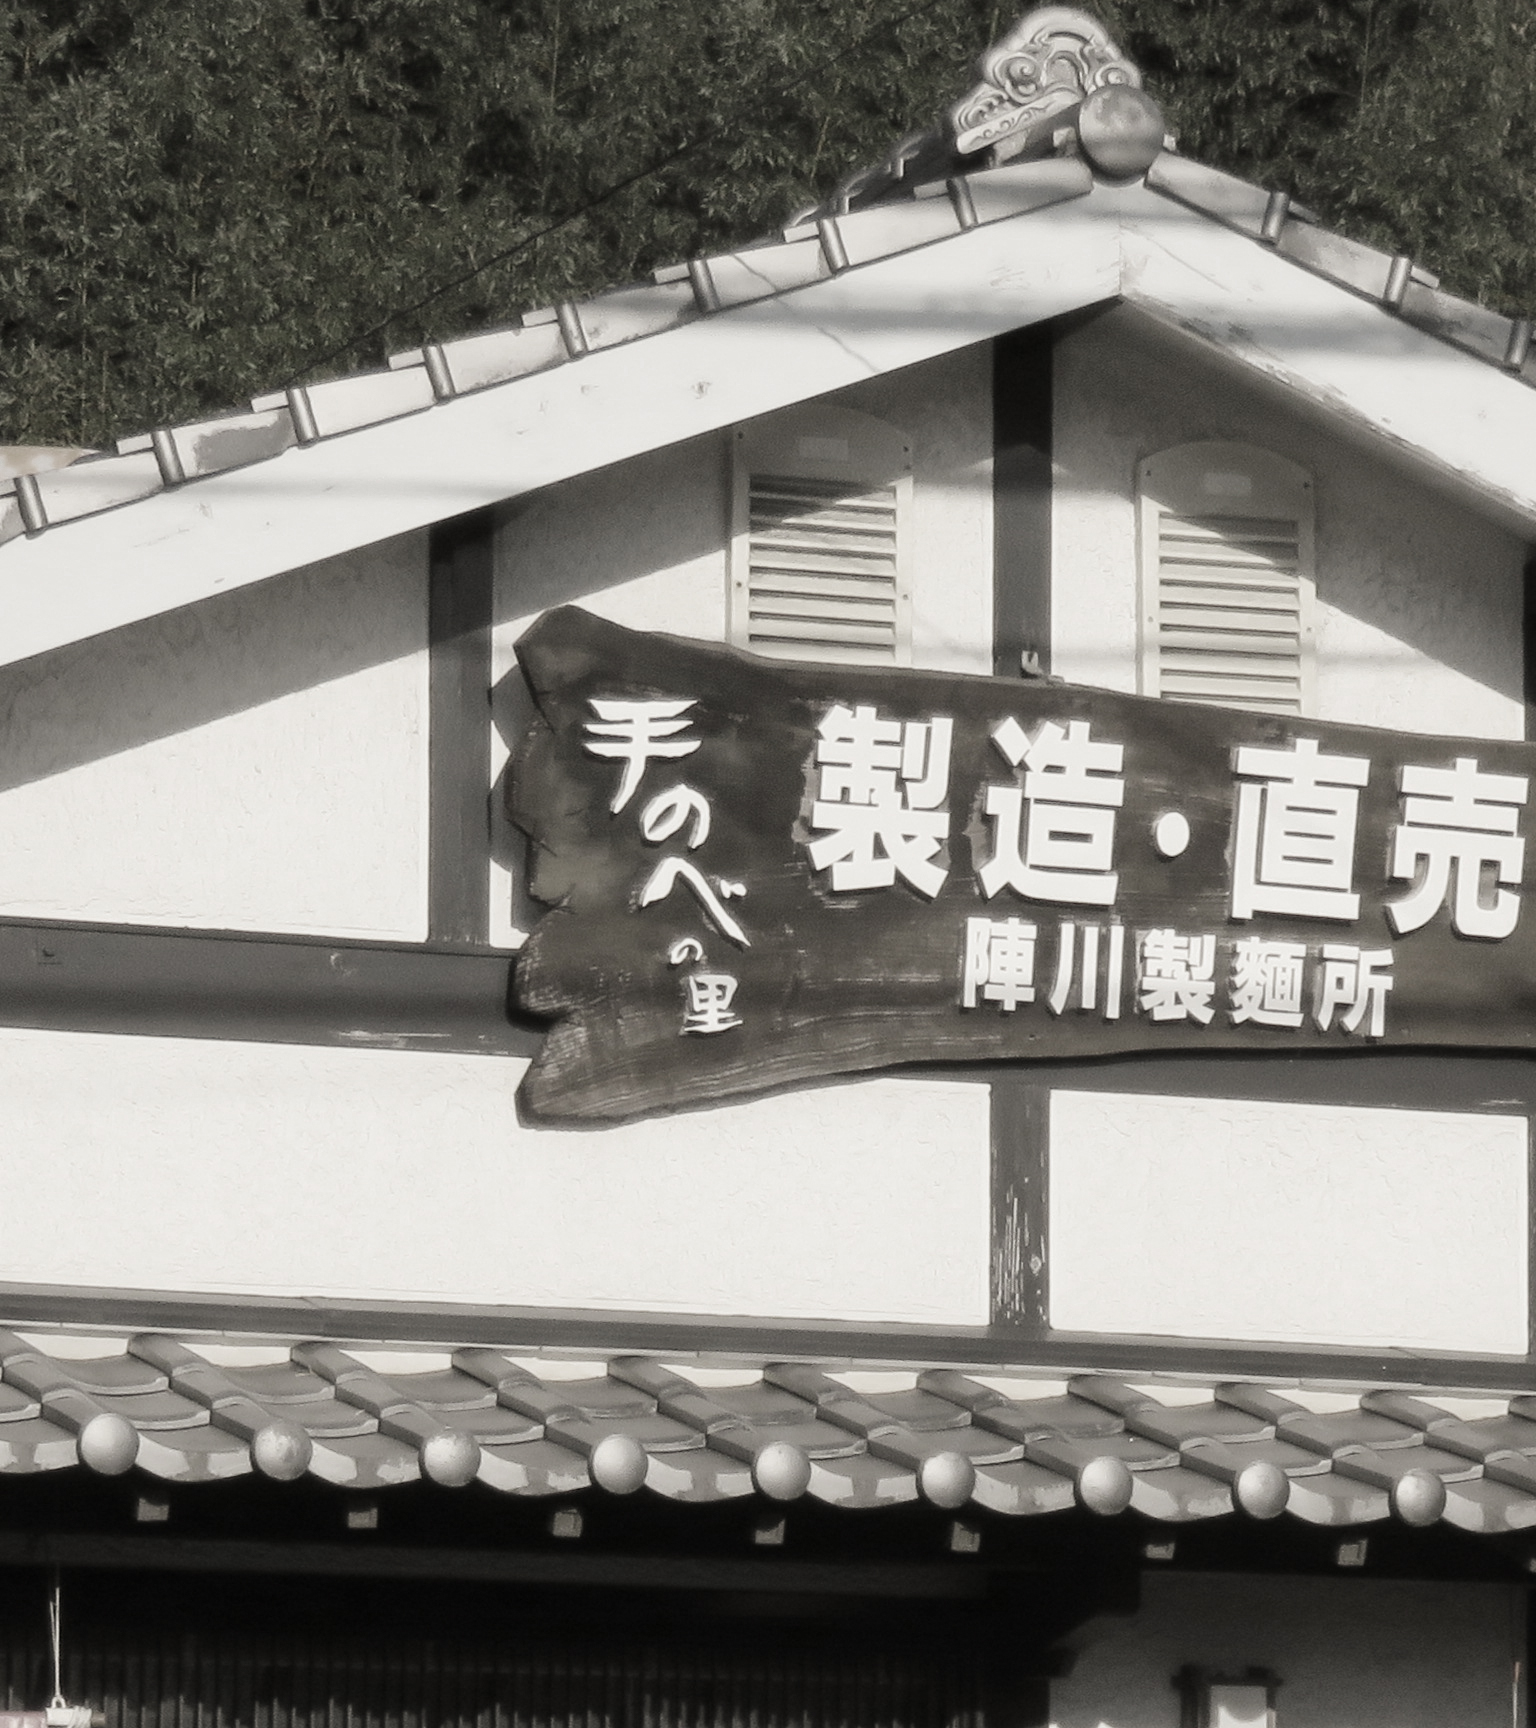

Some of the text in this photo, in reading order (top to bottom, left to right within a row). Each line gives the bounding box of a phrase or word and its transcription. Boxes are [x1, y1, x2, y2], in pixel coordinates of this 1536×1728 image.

[581, 698, 751, 1037] 手のべの里
[806, 703, 1532, 939] 製造・直売
